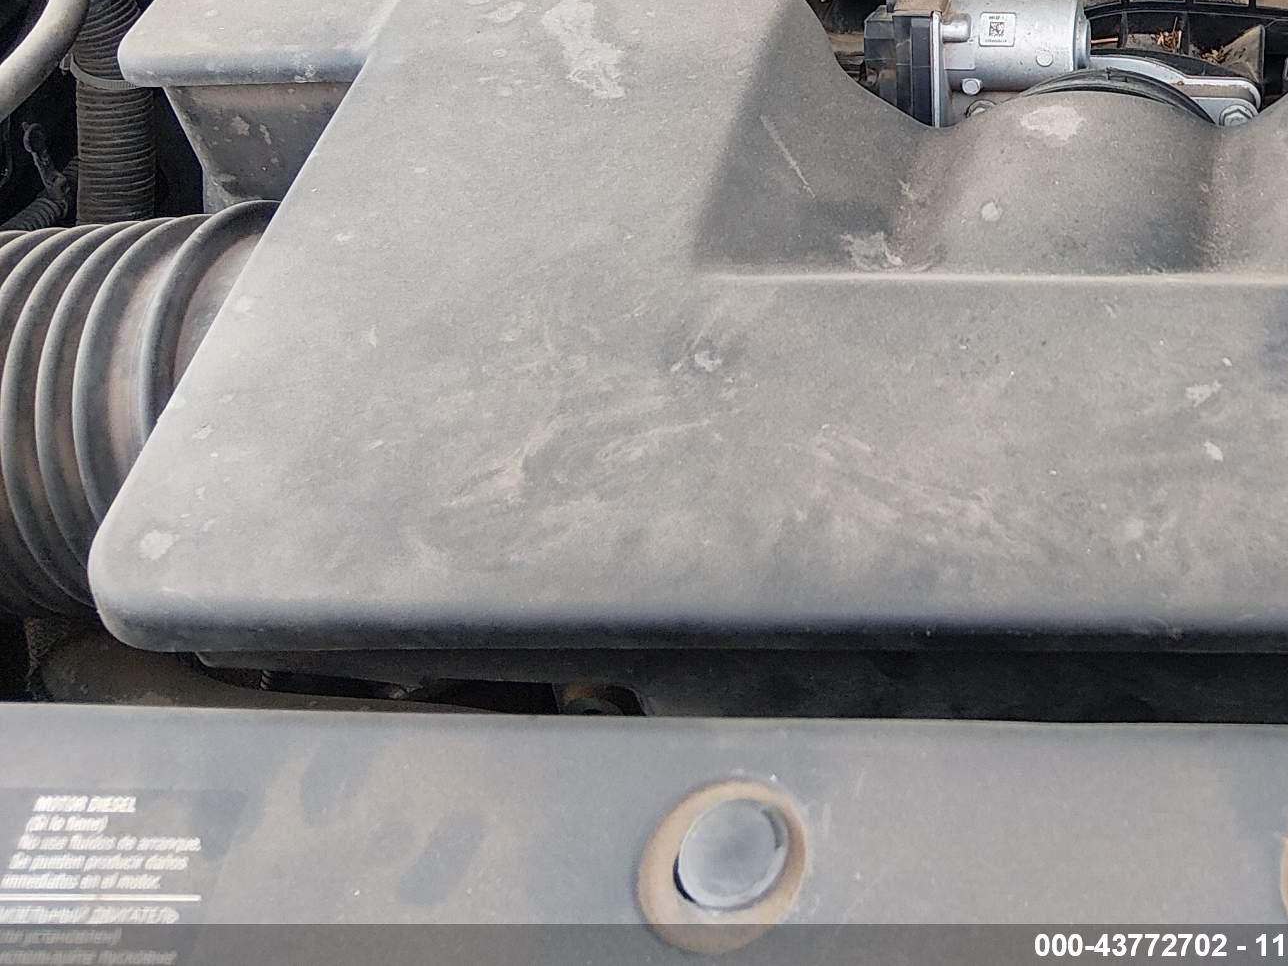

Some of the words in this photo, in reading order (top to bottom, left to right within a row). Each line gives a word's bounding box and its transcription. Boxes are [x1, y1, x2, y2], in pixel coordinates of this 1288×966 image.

[33, 795, 88, 812] MOTOR
[87, 796, 136, 812] DIESEL
[116, 835, 138, 850] de
[29, 854, 86, 871] pueden
[84, 853, 144, 871] producir
[79, 875, 101, 889] en
